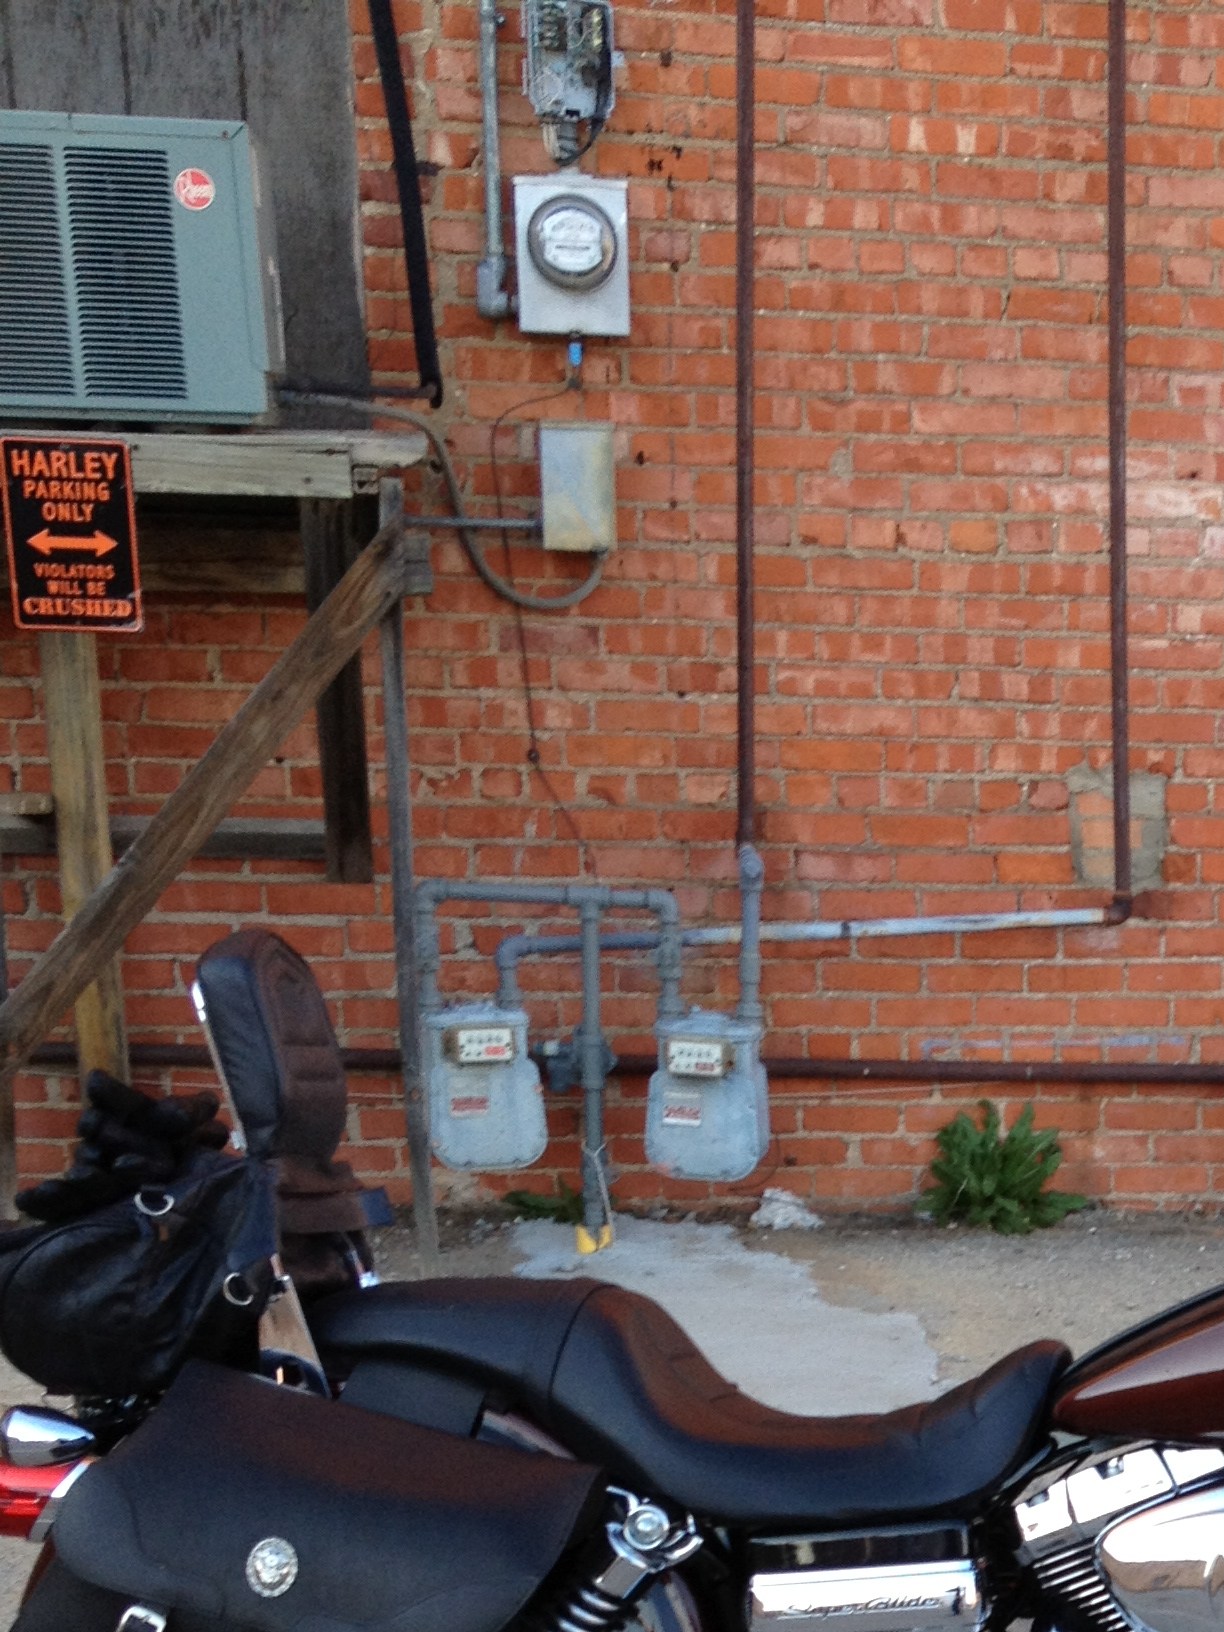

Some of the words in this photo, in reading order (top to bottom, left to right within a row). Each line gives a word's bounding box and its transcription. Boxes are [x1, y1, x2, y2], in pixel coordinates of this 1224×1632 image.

[11, 450, 118, 479] HARLEY
[23, 480, 110, 501] PARKING
[41, 502, 95, 522] ONLY
[33, 562, 115, 579] VIOLATORS
[47, 581, 82, 595] WILL
[87, 581, 106, 596] BE
[22, 597, 133, 617] CRUSHED
